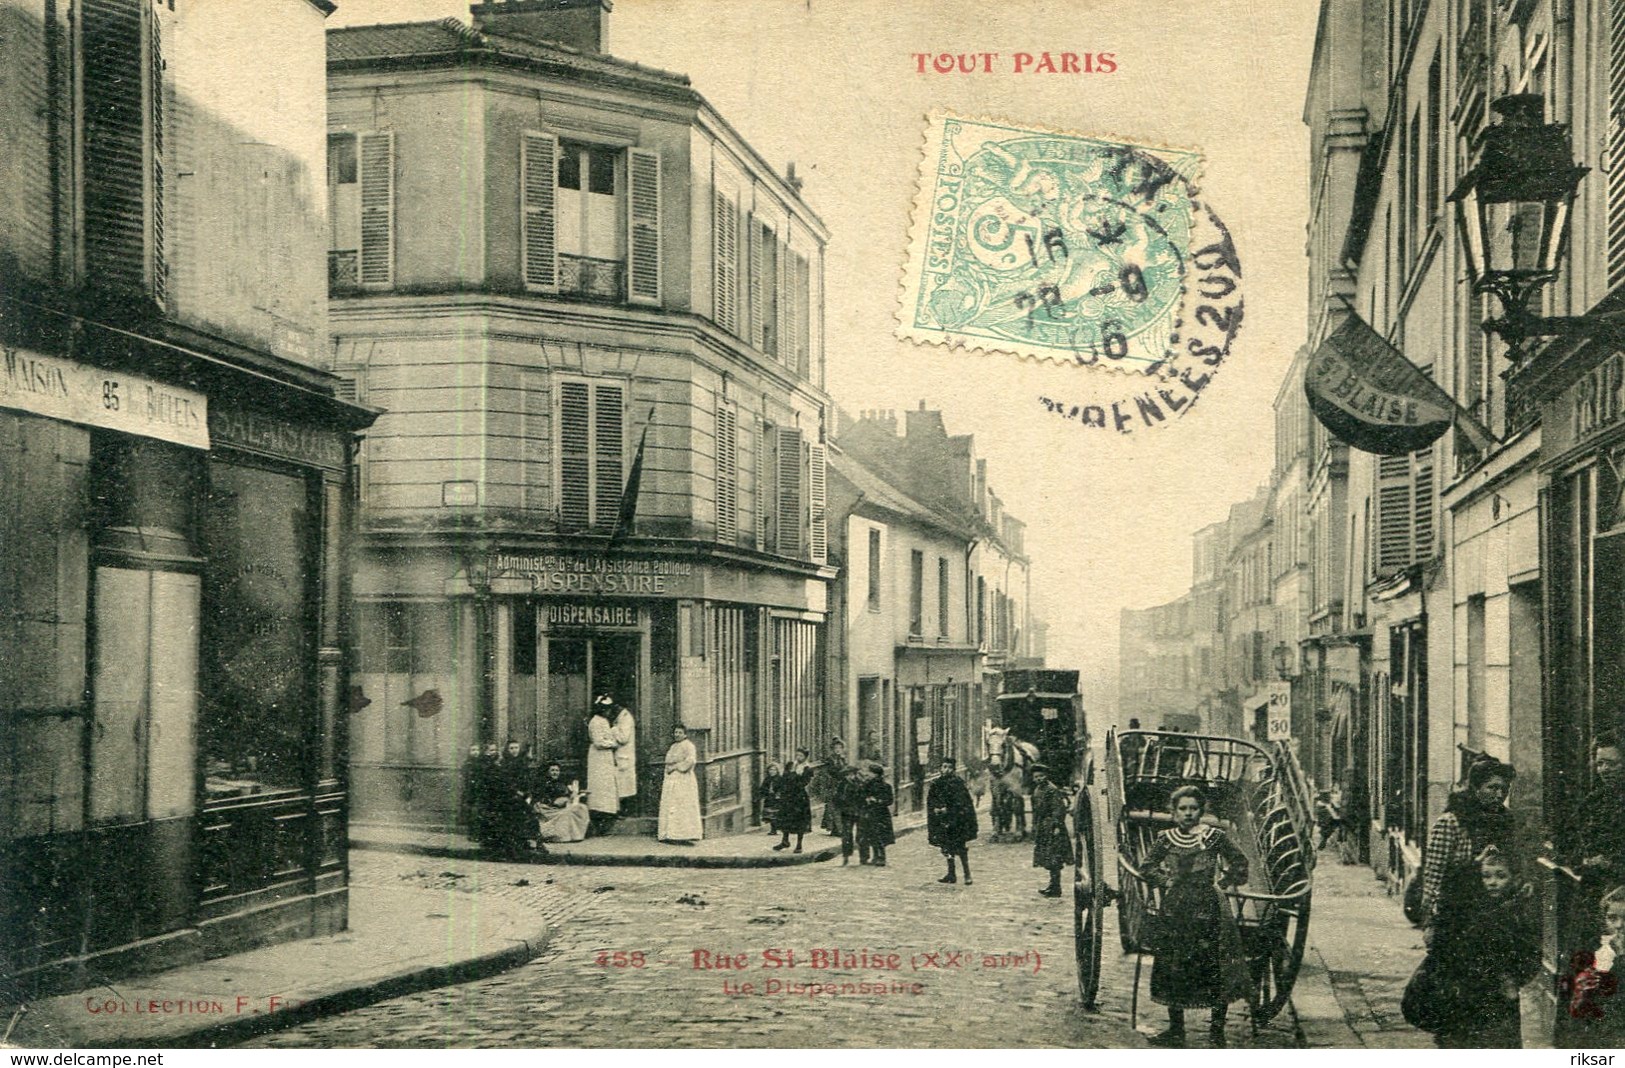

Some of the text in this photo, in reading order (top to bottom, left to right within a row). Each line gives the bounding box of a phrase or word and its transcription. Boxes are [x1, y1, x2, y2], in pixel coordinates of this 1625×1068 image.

[929, 178, 963, 271] POSTES
[4, 349, 69, 399] MAISON
[102, 380, 120, 412] 85
[1329, 376, 1419, 424] BLAISE
[653, 559, 692, 576] Publique
[528, 572, 666, 593] DISPENSAIRE
[1270, 693, 1288, 707] 20
[1270, 720, 1288, 734] 30
